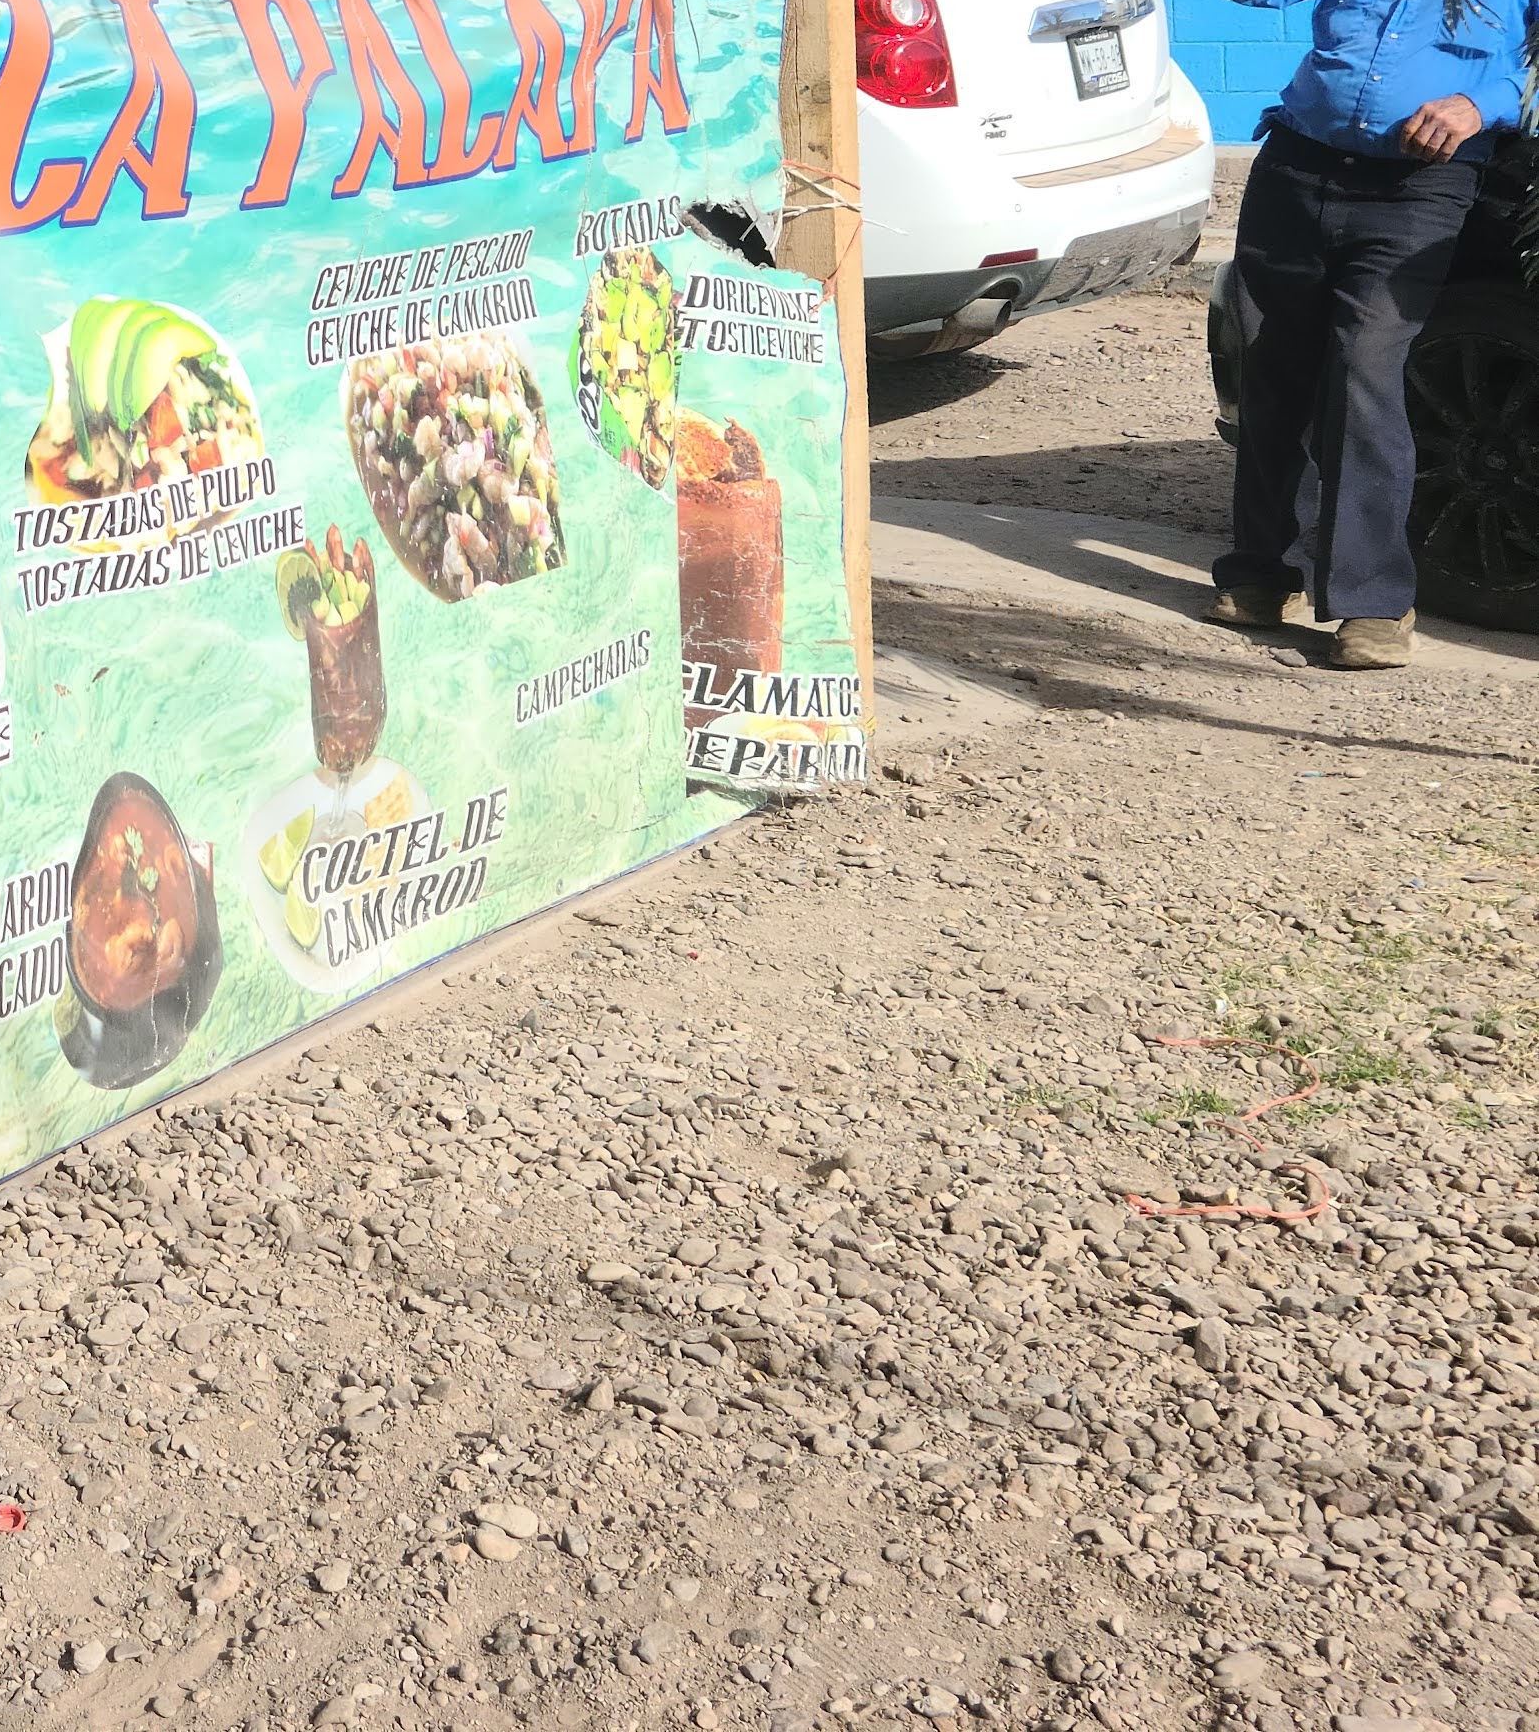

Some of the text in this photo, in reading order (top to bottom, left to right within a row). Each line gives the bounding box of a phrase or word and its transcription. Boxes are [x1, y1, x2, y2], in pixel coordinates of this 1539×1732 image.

[311, 229, 533, 310] CEVICHE DE PESCADO
[576, 195, 685, 257] BOTANAS
[307, 278, 538, 366] CEVICHE DE CAMARON
[681, 317, 824, 364] TOSTICEVICHE
[682, 274, 820, 324] DORICEVICHE
[14, 457, 276, 553] TOSTADAS DE PULPO
[18, 505, 305, 613] TOSTADAS DE CEVICHE
[516, 629, 651, 723] CAMPECHANAS
[302, 787, 508, 904] COCTEL DE
[323, 856, 488, 969] CAMARON
